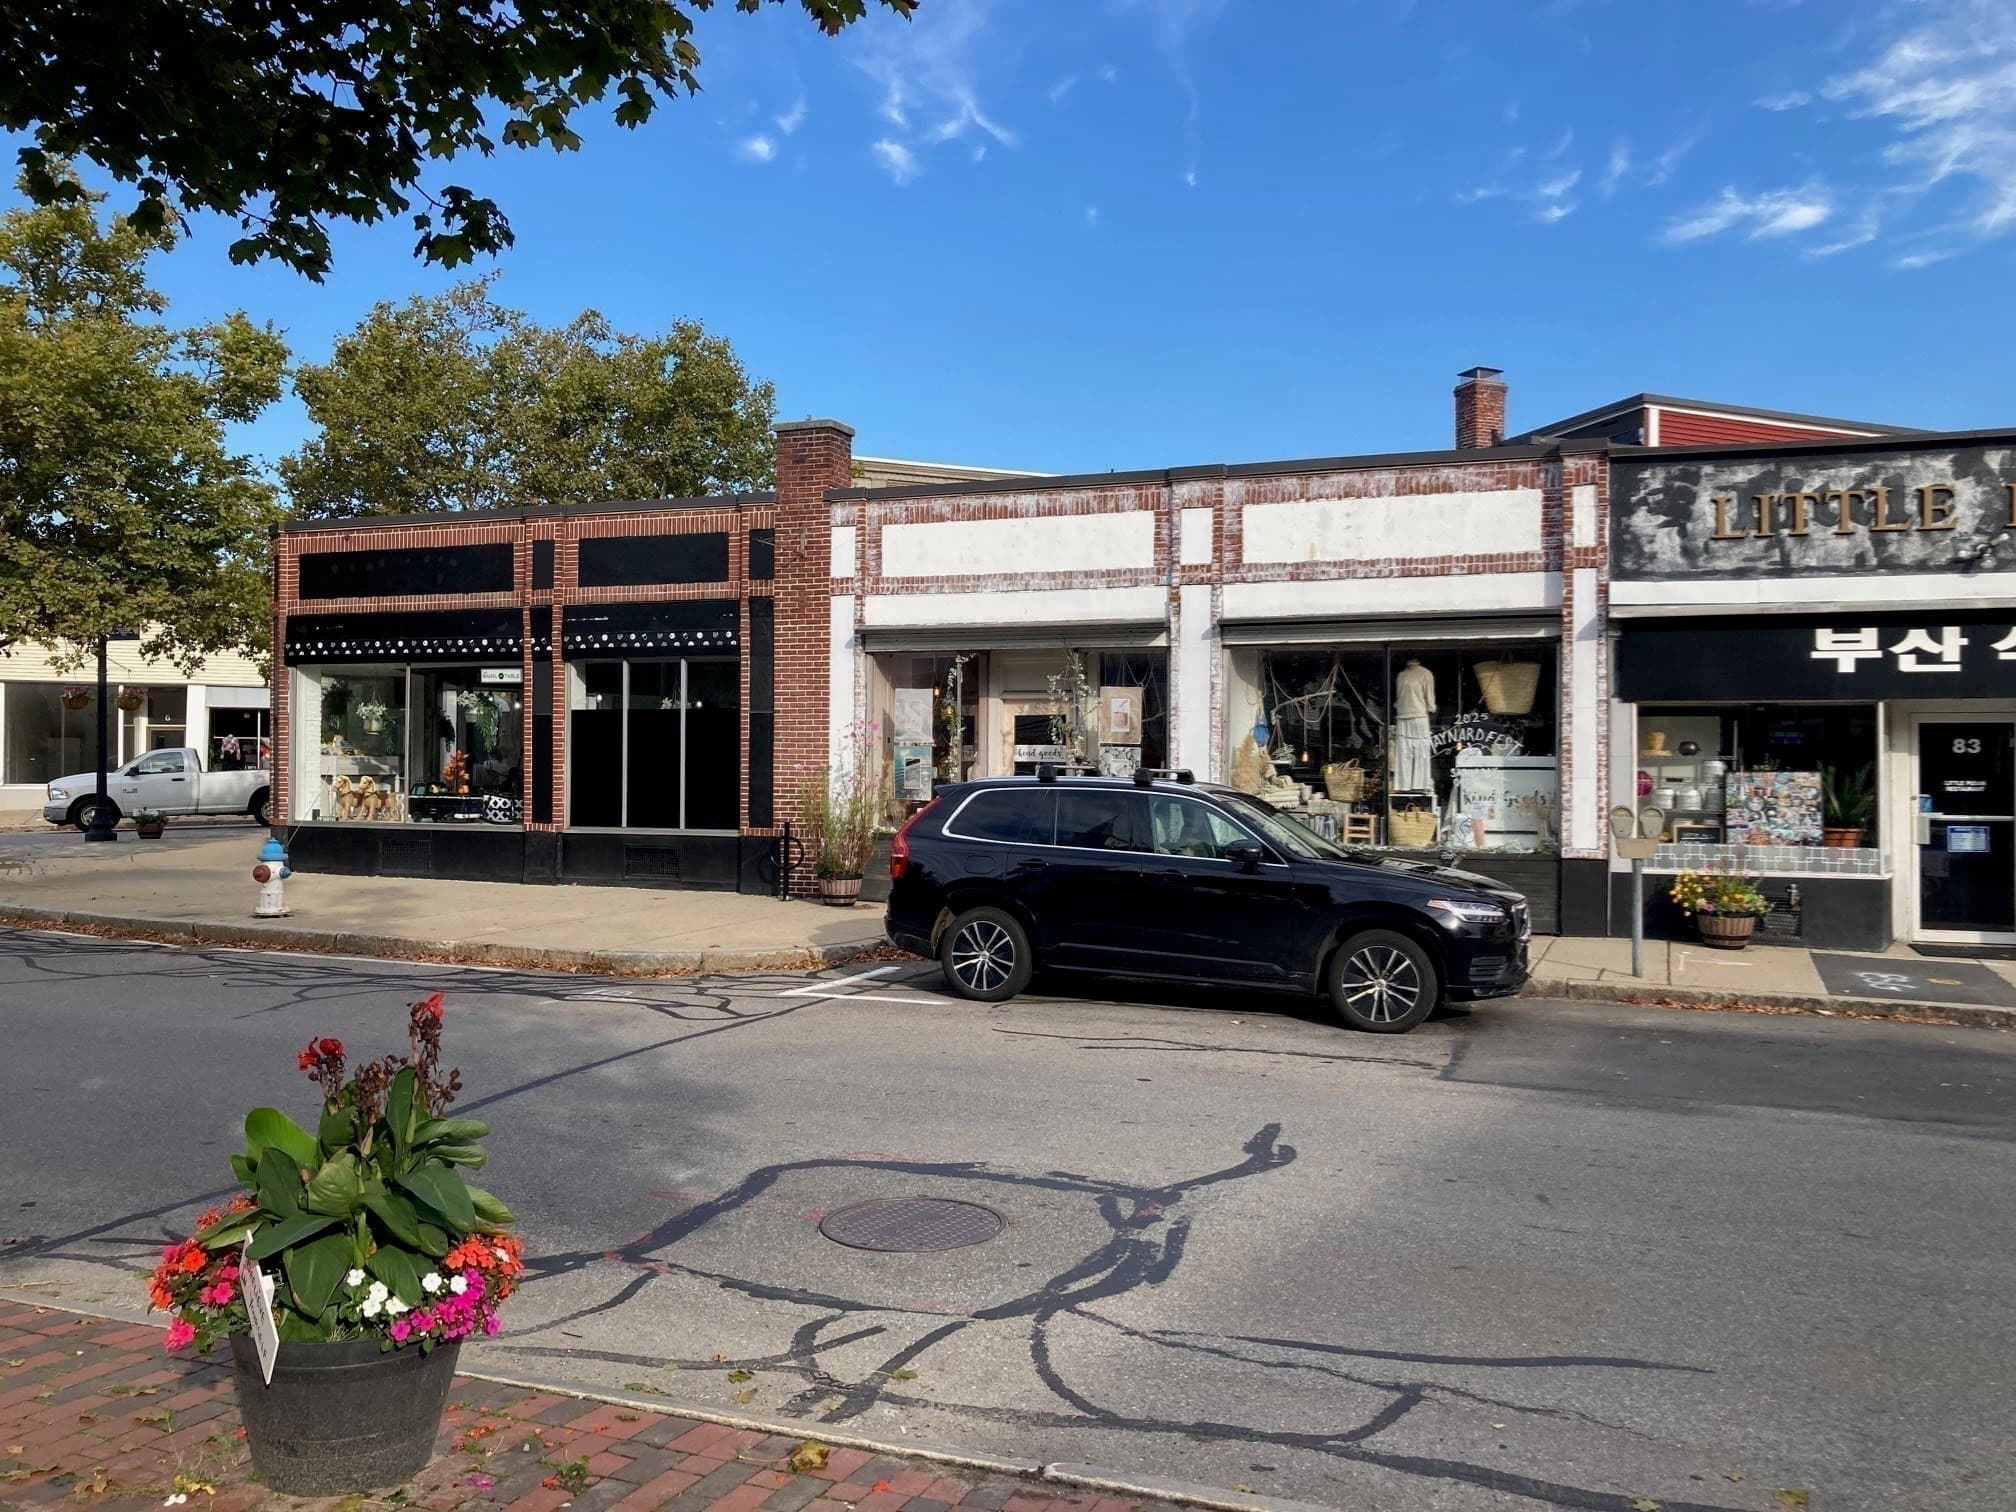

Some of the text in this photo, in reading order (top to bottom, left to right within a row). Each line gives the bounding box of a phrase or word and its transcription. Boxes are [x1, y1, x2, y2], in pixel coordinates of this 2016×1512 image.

[1711, 483, 1960, 540] LITTLE
[1810, 626, 1968, 673] 부산
[1454, 712, 1489, 725] 2025
[1952, 738, 1982, 754] 83
